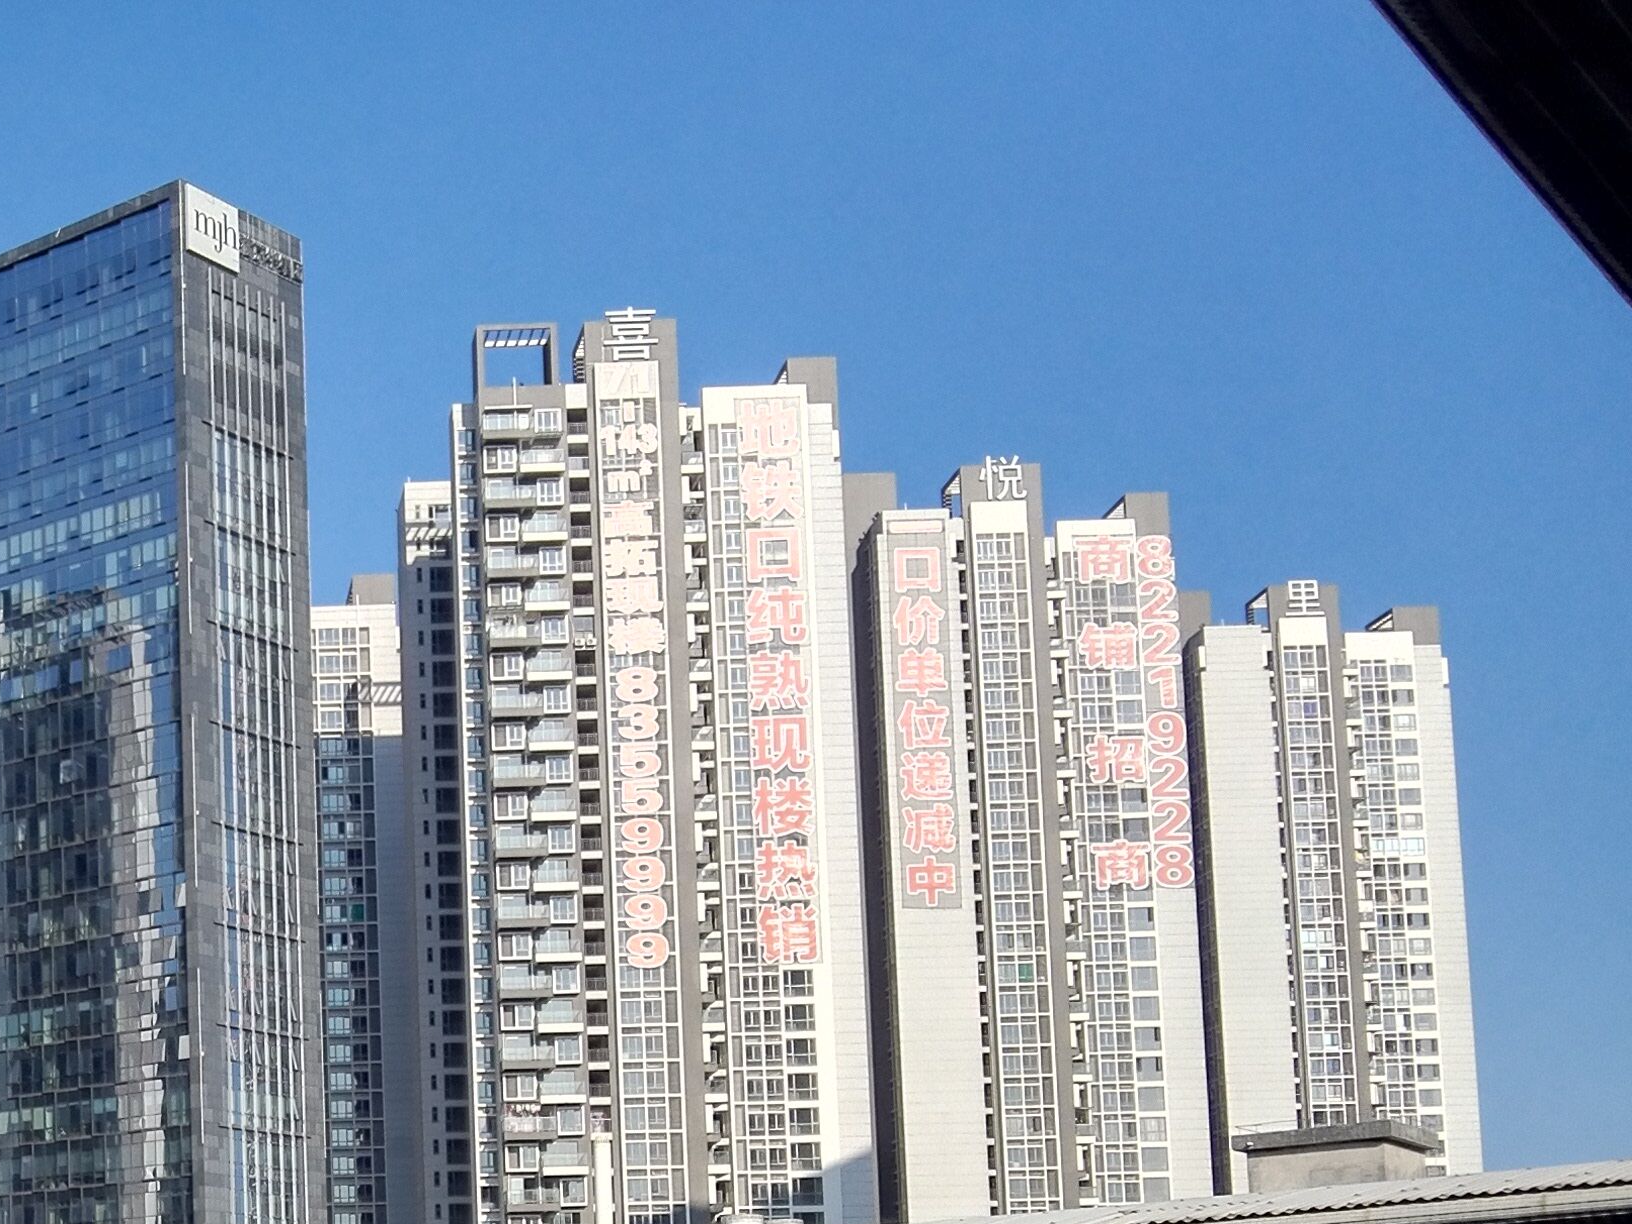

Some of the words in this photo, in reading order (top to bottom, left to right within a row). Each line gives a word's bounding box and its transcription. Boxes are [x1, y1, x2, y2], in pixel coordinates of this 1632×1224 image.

[194, 209, 238, 253] mjh
[603, 306, 659, 361] 喜
[979, 455, 1028, 500] 悦
[1285, 580, 1325, 616] 里
[615, 667, 669, 968] 83559999
[737, 398, 818, 963] 地铁口纯熟现楼热销
[887, 520, 958, 907] 一口价单位递减中
[1074, 535, 1151, 892] 商铺招商
[1136, 534, 1196, 889] 82219228
